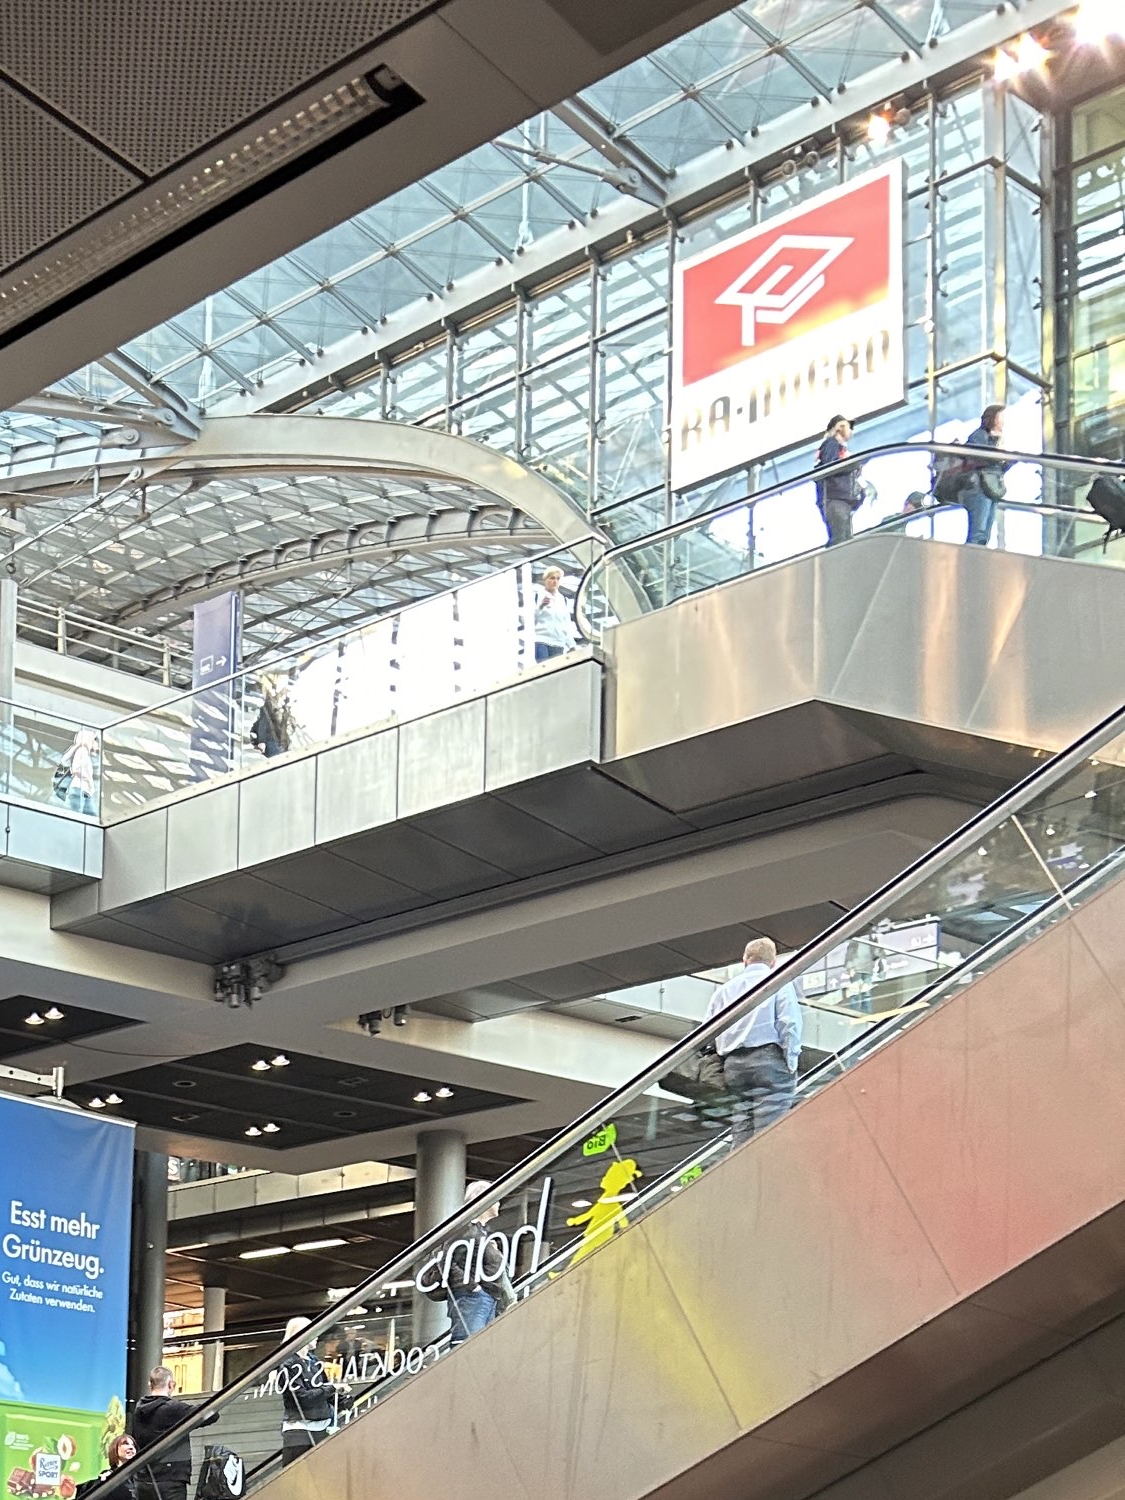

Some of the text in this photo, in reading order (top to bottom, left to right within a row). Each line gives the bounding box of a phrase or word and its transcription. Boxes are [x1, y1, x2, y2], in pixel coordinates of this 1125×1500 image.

[10, 1200, 100, 1239] Esst mehr
[2, 1233, 105, 1280] Grünzeug.
[1, 1271, 104, 1300] Gut, dass wir natürliche
[9, 1288, 96, 1313] Zutaten verwenden.
[38, 1469, 59, 1479] SPORT
